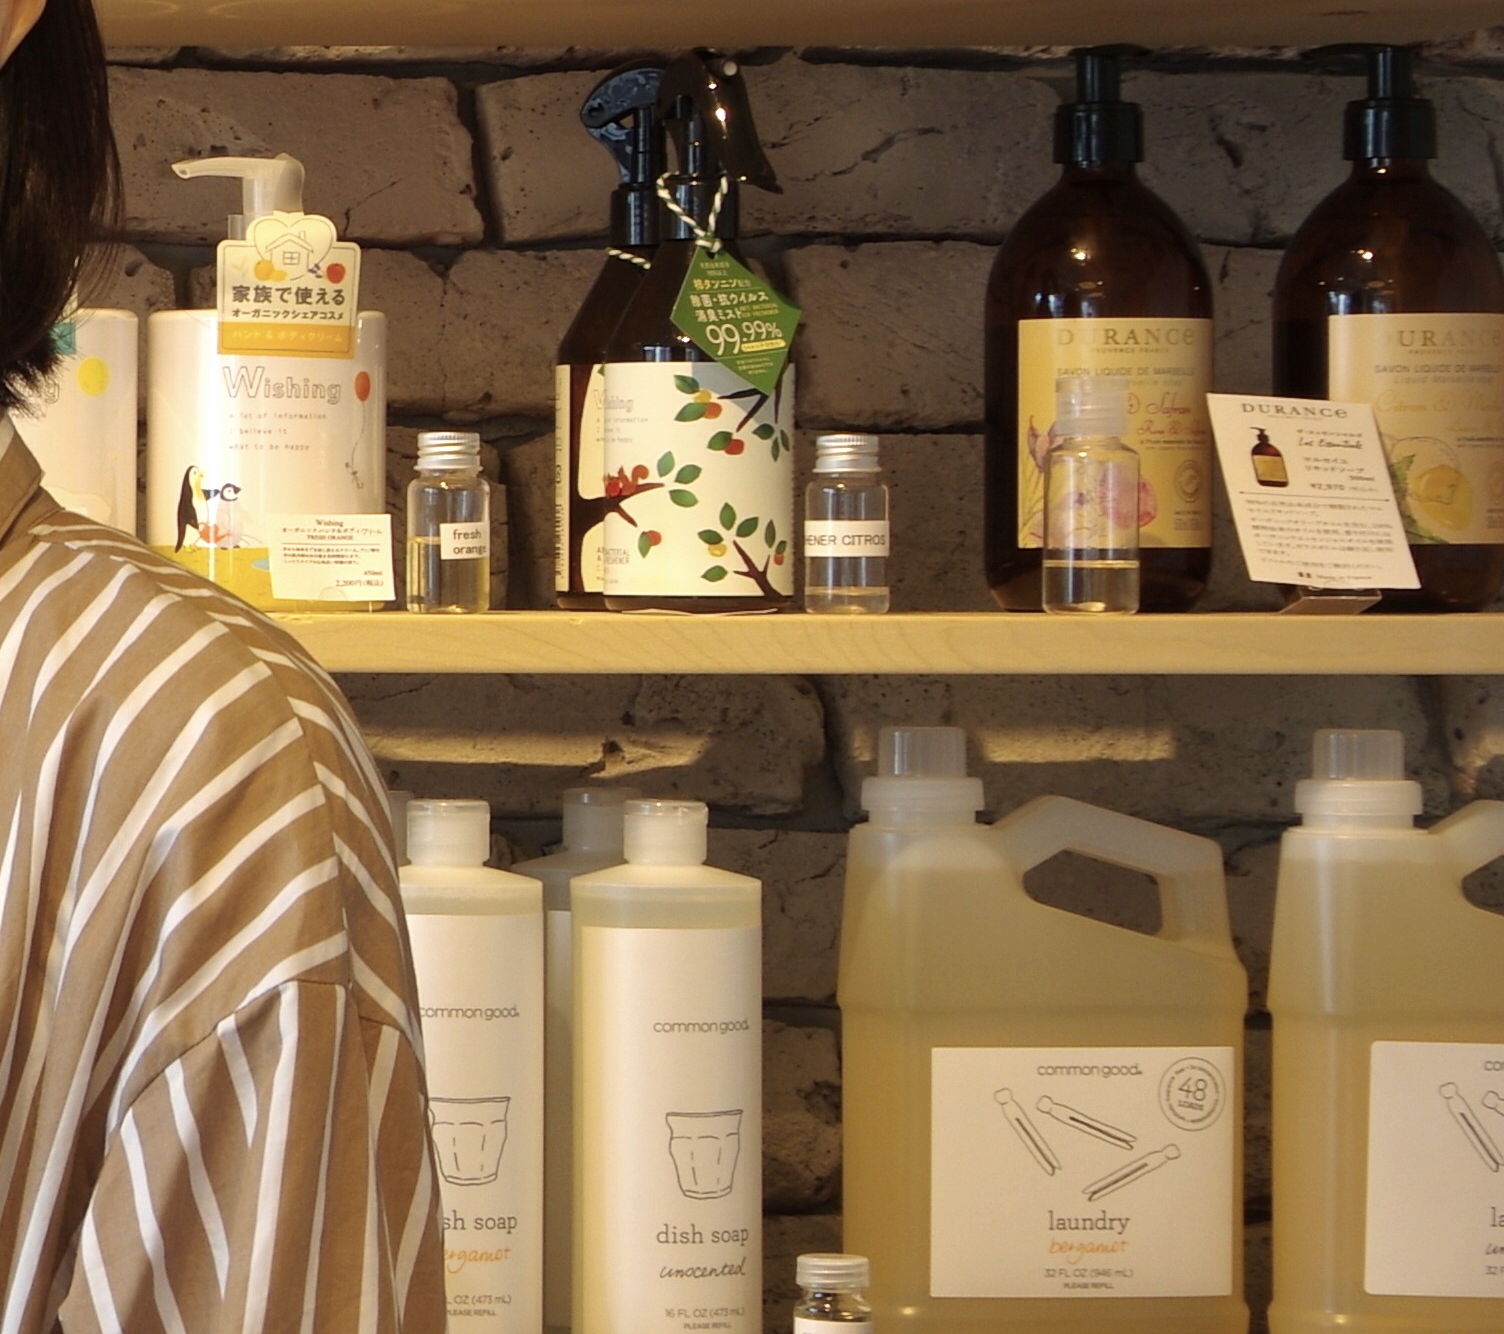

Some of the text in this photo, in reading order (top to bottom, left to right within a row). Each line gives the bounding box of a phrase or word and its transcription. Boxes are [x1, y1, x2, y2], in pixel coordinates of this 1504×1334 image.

[232, 285, 345, 305] 家族で使える
[232, 309, 344, 321] オーガニックシェアコスメ
[705, 321, 783, 356] 99.99%
[223, 366, 341, 404] Wishing
[454, 529, 482, 540] fresh
[805, 535, 838, 546] HENER
[454, 543, 487, 555] orange
[1178, 1078, 1207, 1101] 48
[474, 1215, 517, 1233] soap
[1049, 1210, 1129, 1234] laundry
[656, 1224, 748, 1245] dish soap
[443, 1247, 511, 1273] ergamot
